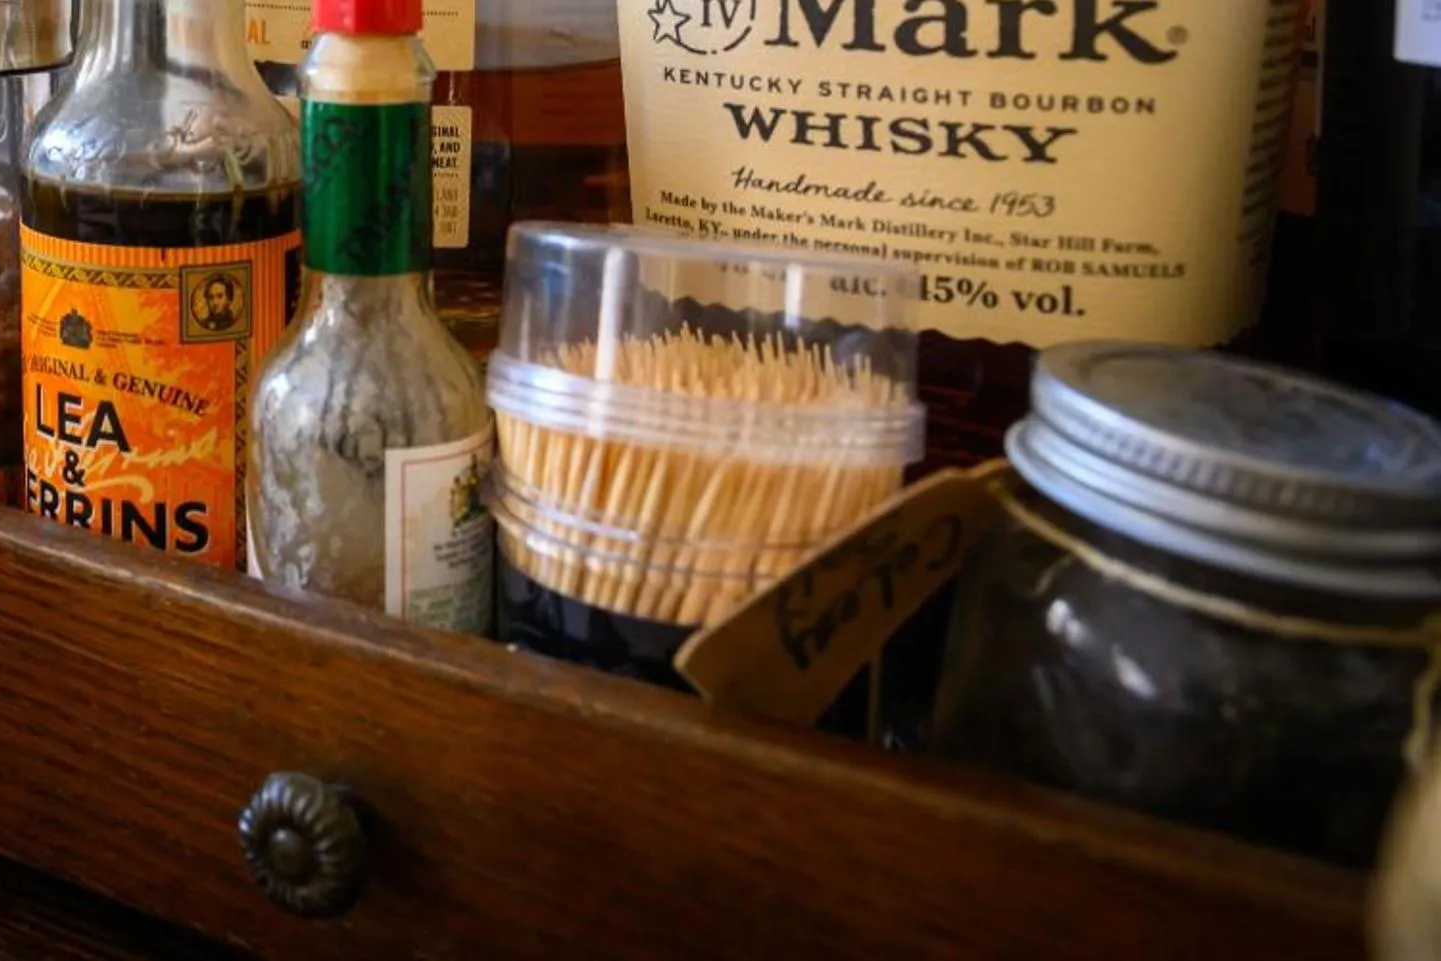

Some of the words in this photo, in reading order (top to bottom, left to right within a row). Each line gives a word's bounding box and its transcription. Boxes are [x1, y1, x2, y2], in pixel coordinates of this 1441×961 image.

[663, 66, 803, 95] KENTUCKY
[818, 80, 973, 108] STRAIGHT
[989, 91, 1157, 116] BOURBON
[722, 101, 1079, 164] WHISKY
[731, 166, 892, 203] Handmade
[899, 188, 980, 213] since
[989, 191, 1056, 218] 1953
[660, 190, 697, 209] Made
[700, 196, 718, 217] by
[723, 200, 747, 217] the
[750, 204, 815, 226] Maker's
[820, 213, 866, 232] Mark
[872, 218, 959, 246] Distillery
[1010, 231, 1050, 250] Star
[1057, 234, 1095, 253] Hill
[732, 226, 778, 242] under
[782, 230, 809, 248] the
[892, 246, 1000, 270] supervision
[1006, 256, 1026, 273] of
[1031, 257, 1077, 277] ROB
[1081, 260, 1187, 280] SAMUELS
[1010, 285, 1087, 317] vol.
[36, 382, 132, 454] LEA
[94, 368, 109, 387] &
[113, 370, 210, 418] GENUINE
[62, 449, 87, 487] &
[26, 466, 210, 554] ERRINS
